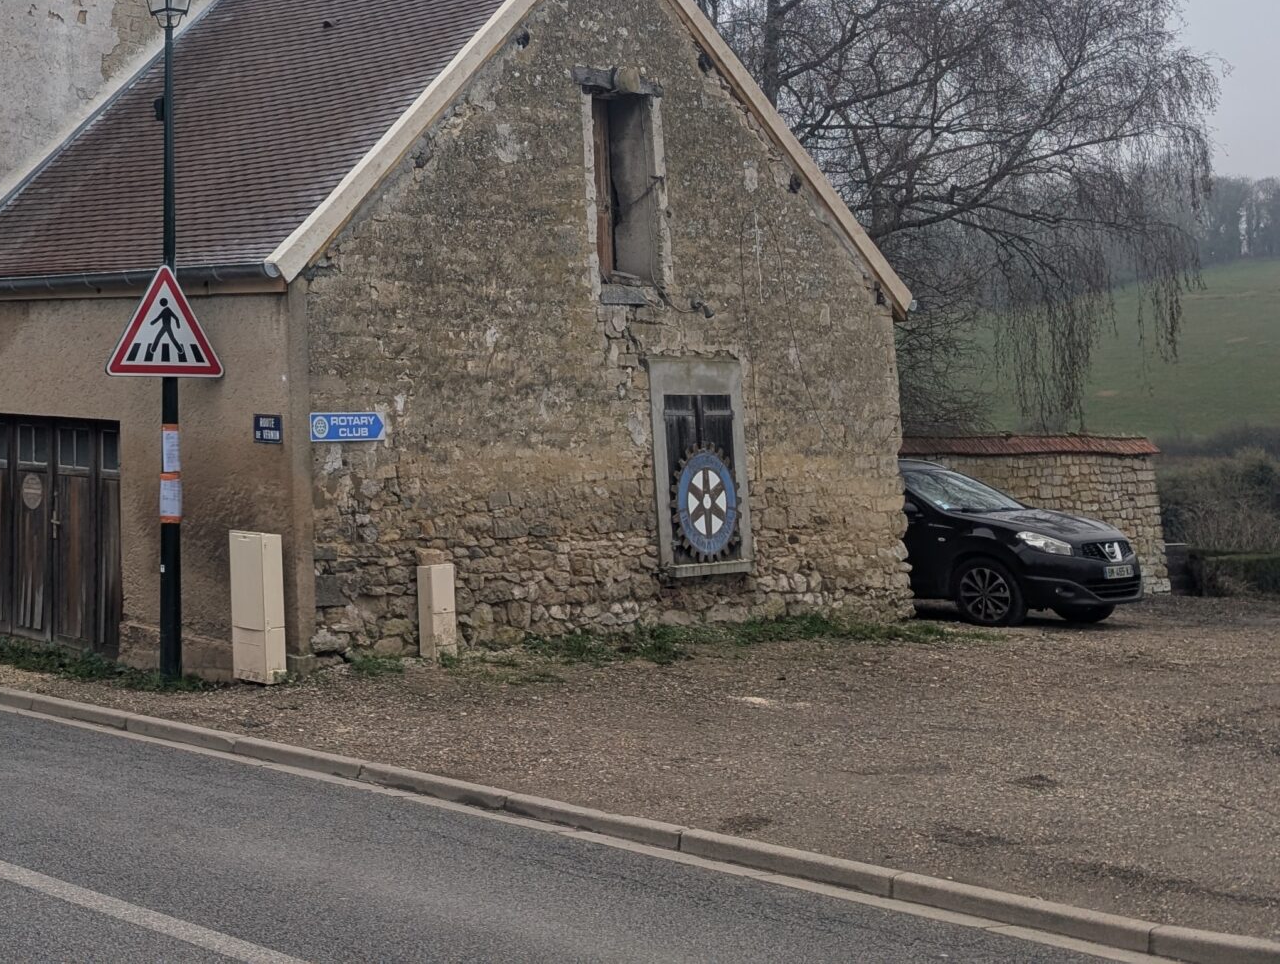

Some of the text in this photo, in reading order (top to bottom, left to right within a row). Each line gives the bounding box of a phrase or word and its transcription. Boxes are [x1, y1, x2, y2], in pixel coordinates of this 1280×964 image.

[259, 417, 275, 428] ROUTE
[330, 416, 375, 426] ROTARY
[255, 430, 262, 439] DE
[338, 427, 369, 437] CLUB
